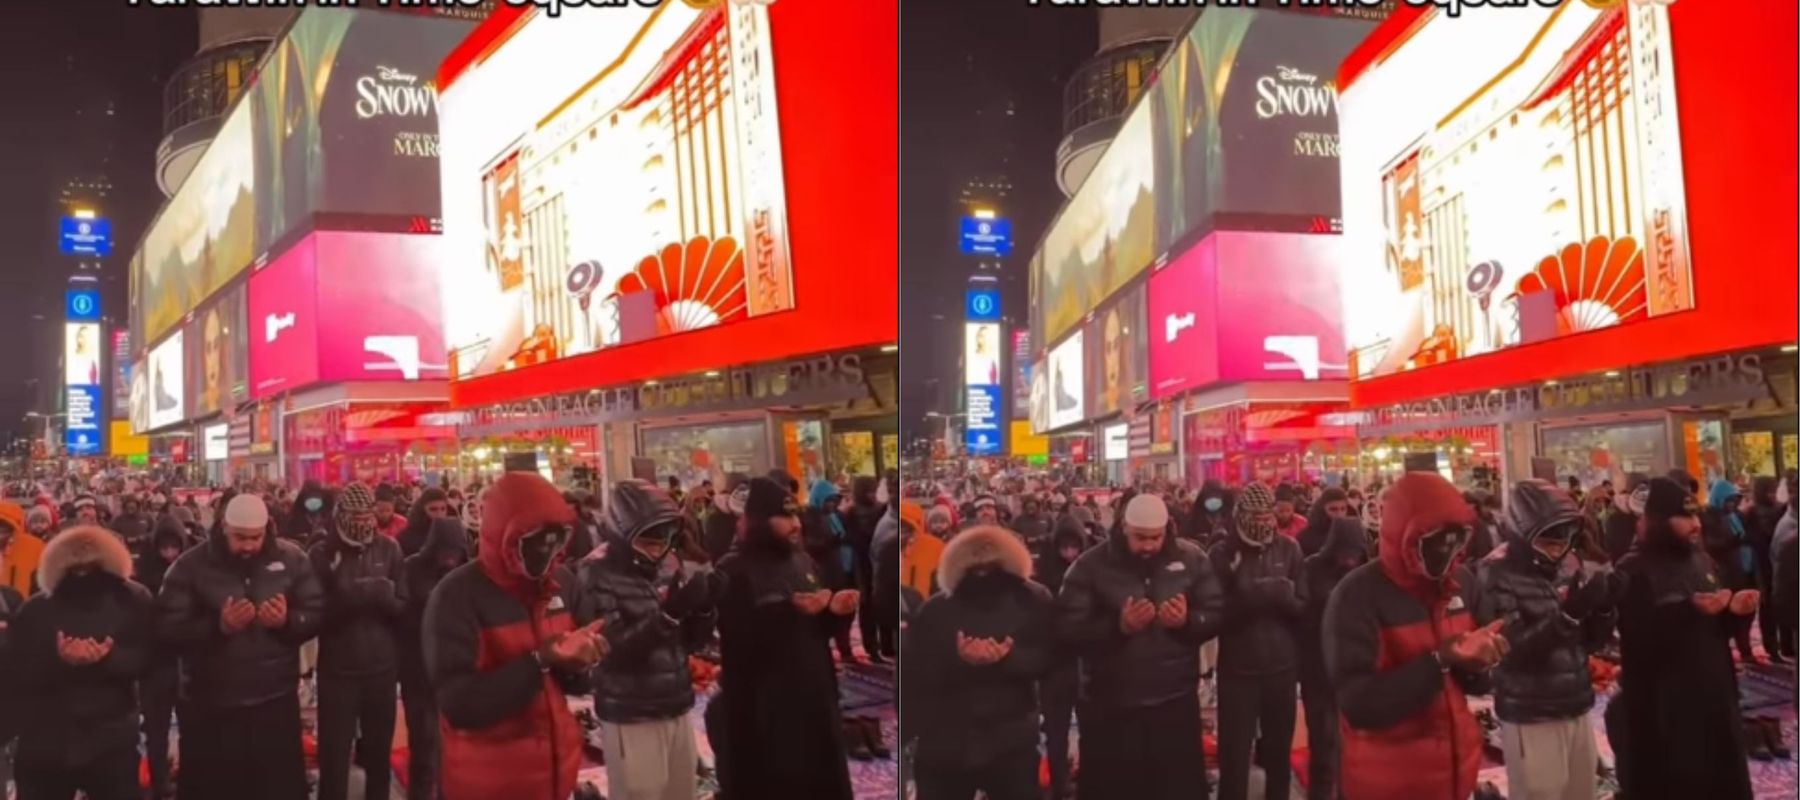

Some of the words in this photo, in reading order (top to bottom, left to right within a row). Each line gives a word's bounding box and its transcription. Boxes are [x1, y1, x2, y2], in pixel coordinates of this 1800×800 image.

[375, 65, 417, 84] Disney
[1275, 65, 1317, 84] Disney
[356, 77, 431, 118] SNOW
[1256, 77, 1331, 118] SNOW
[558, 387, 629, 418] EAGLE
[1458, 387, 1529, 418] EAGLE
